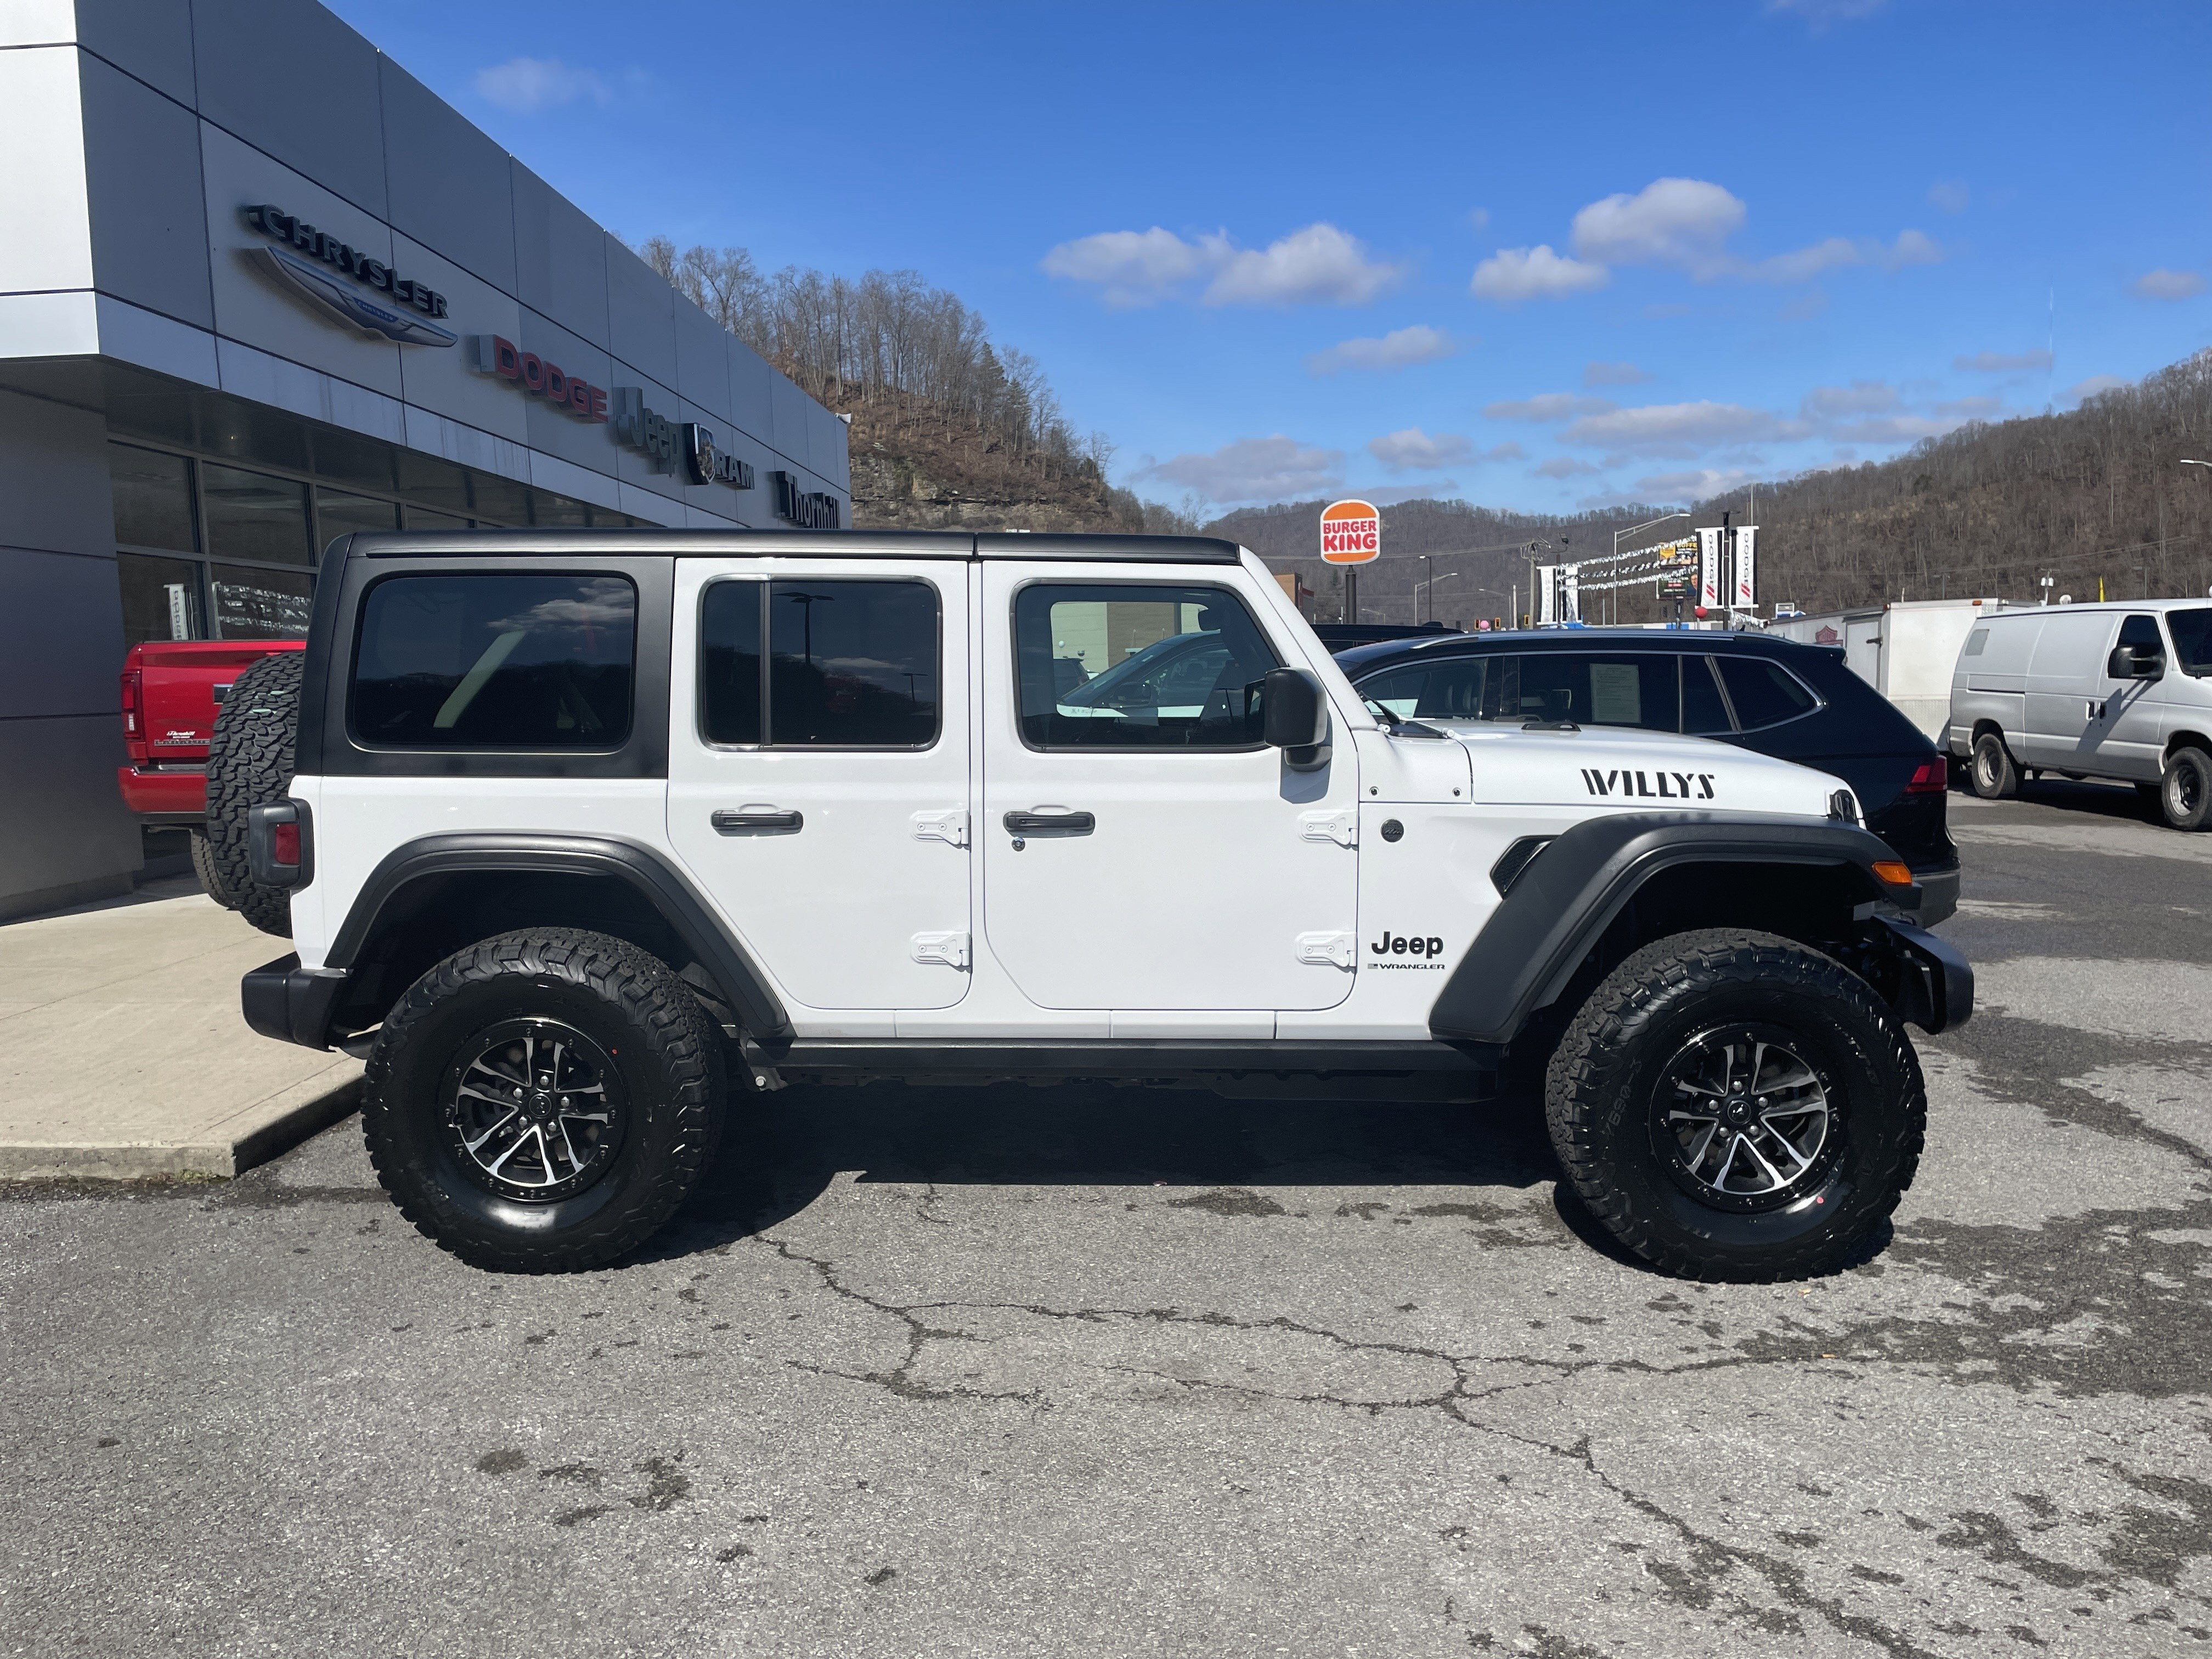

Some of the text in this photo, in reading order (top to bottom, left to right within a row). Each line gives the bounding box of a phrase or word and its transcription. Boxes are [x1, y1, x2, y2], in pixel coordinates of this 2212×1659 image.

[262, 204, 449, 319] CHRYSLER
[494, 335, 608, 423] DODGE
[625, 386, 684, 477] Jeep
[714, 448, 755, 490] RAM
[782, 471, 840, 529] Thornhill
[1323, 520, 1376, 534] BURGER
[1324, 533, 1376, 552] KING
[1581, 769, 1715, 799] WILLYS
[1371, 931, 1443, 959] Jeep
